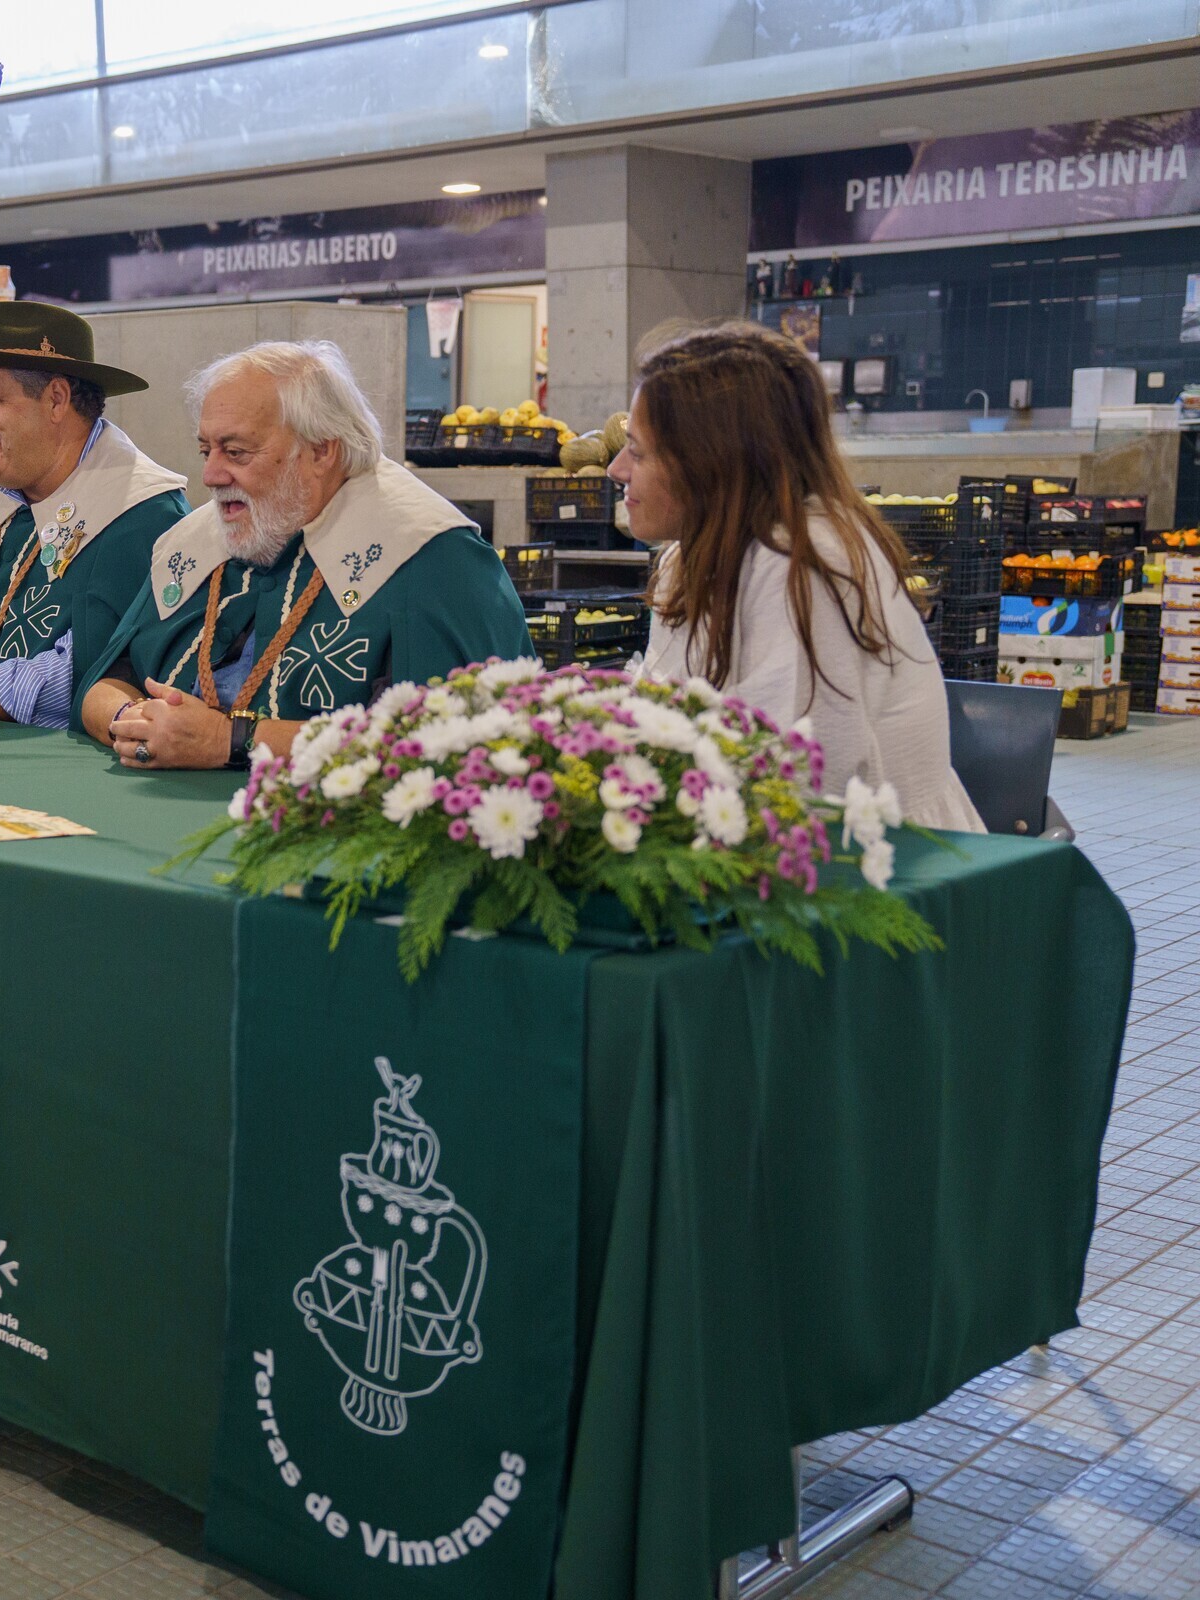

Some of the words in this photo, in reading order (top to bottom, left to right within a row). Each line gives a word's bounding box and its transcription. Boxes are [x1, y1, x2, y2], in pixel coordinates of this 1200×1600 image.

[845, 166, 986, 212] PEIXARIA
[995, 144, 1188, 198] TERESINHA
[203, 239, 301, 275] PEIXARIAS
[304, 231, 398, 266] ALBERTO
[253, 1348, 302, 1488] Terras
[304, 1491, 350, 1539] de
[359, 1450, 527, 1567] Vimaranes
